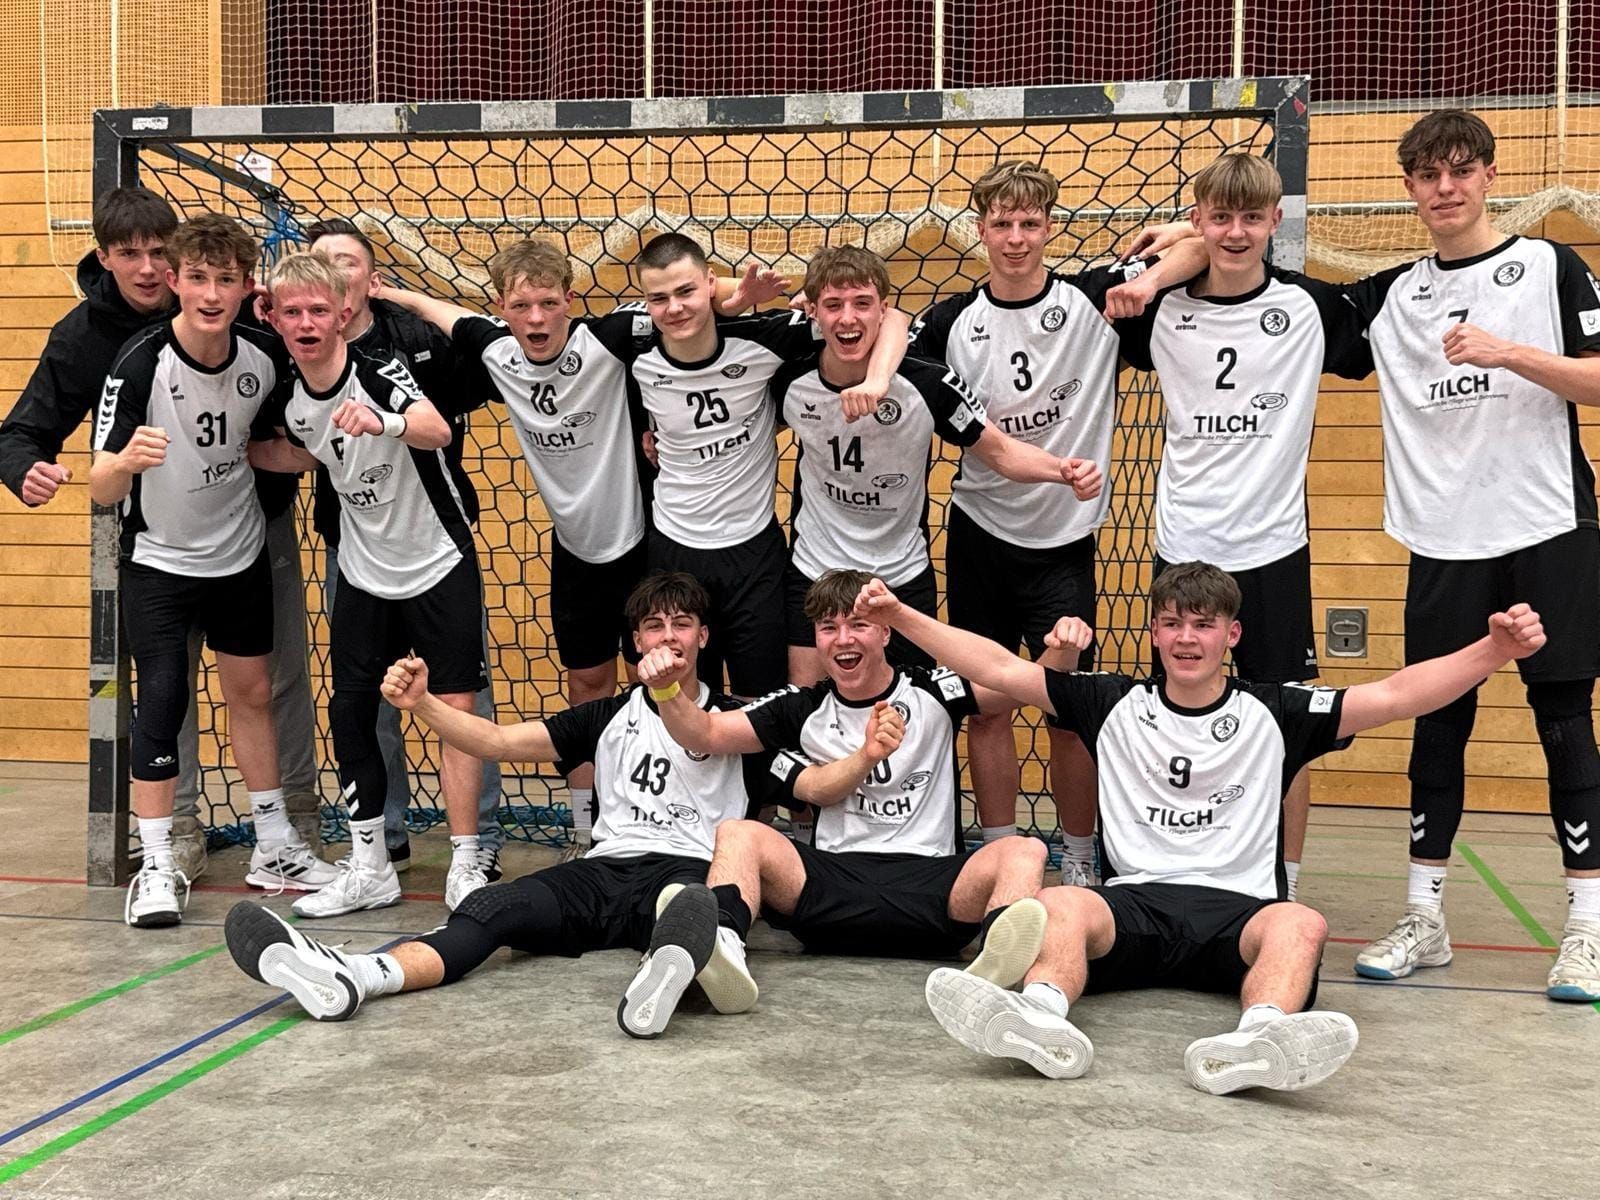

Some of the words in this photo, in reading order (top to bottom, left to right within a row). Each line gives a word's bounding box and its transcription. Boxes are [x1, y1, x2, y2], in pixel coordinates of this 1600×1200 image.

[1010, 351, 1033, 392] 3
[1215, 347, 1238, 390] 2
[530, 382, 559, 416] 16
[1428, 373, 1490, 400] TILCH
[686, 388, 730, 430] 25
[800, 412, 822, 421] erima
[1000, 405, 1060, 434] TILCH
[1193, 415, 1258, 433] TILCH
[196, 411, 227, 447] 31
[692, 429, 751, 460] TILCH
[827, 435, 864, 473] 14
[824, 481, 880, 506] TILCH
[630, 753, 671, 796] 43
[1168, 755, 1193, 789] 9
[1146, 806, 1213, 827] TILCH
